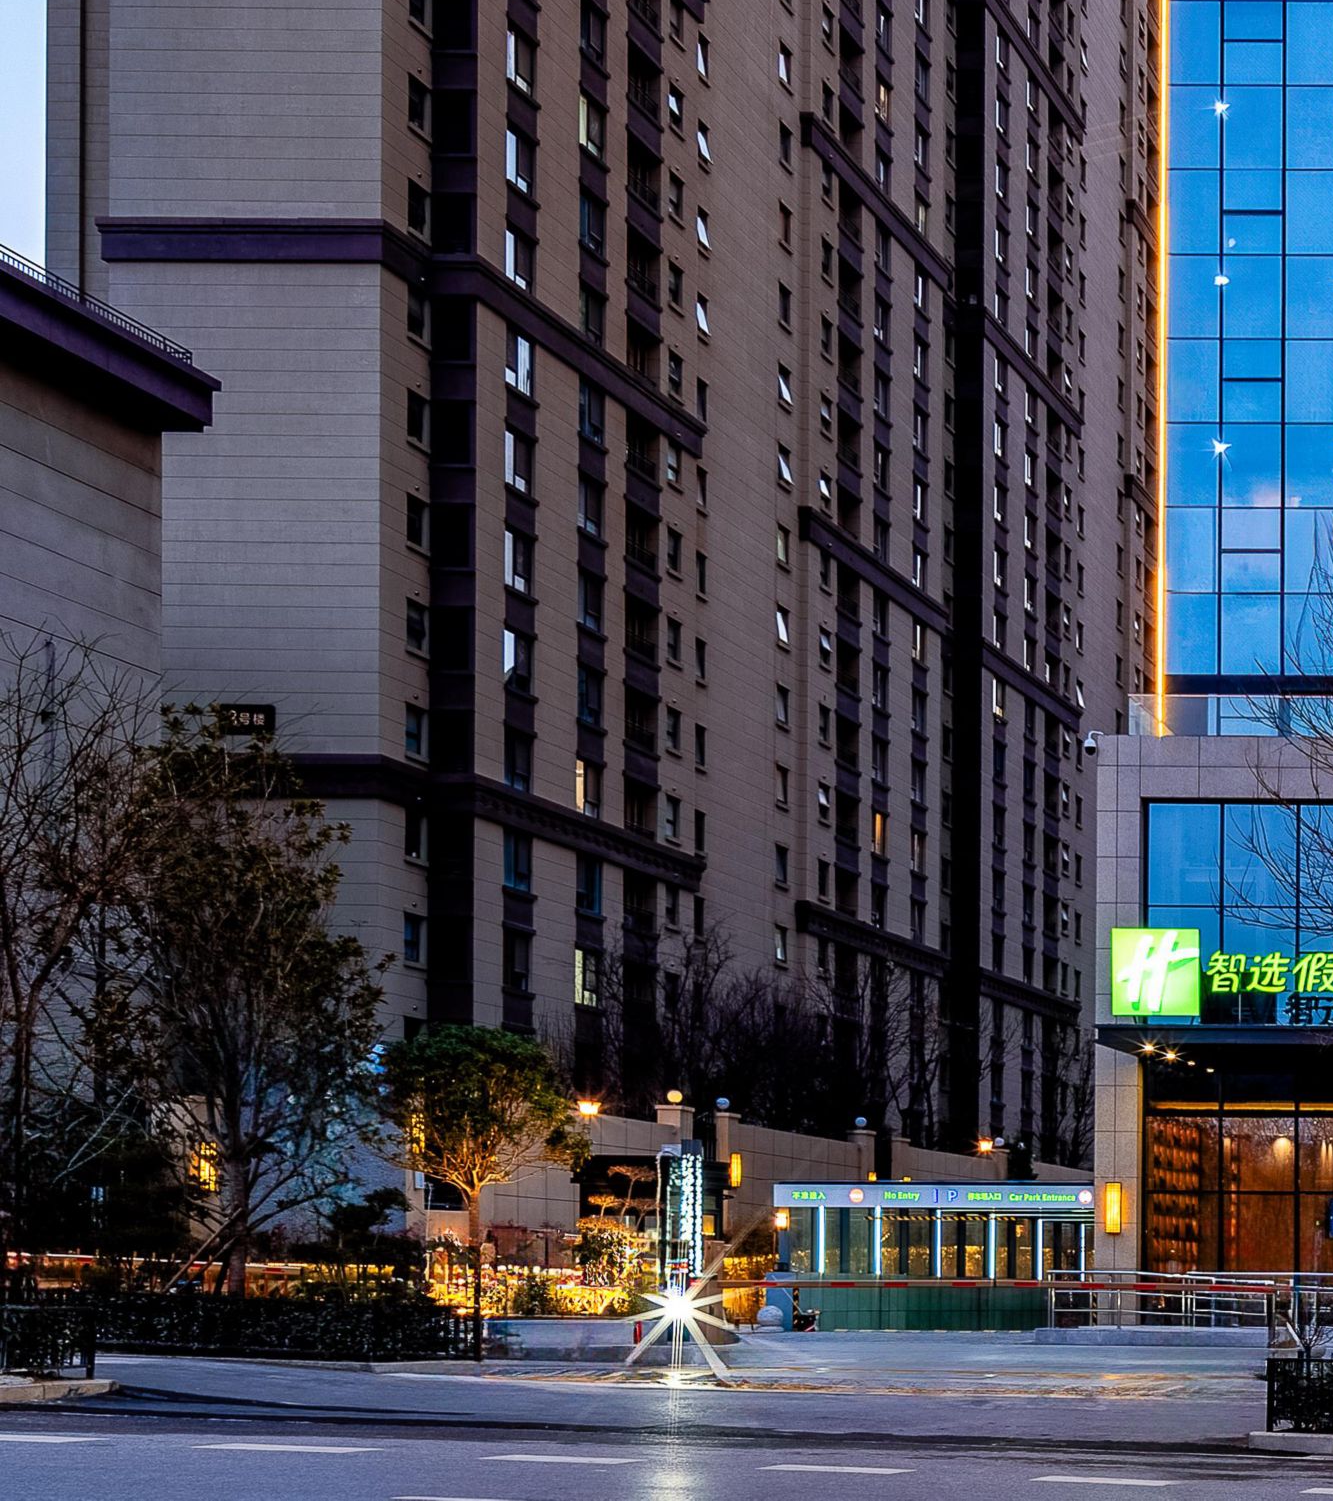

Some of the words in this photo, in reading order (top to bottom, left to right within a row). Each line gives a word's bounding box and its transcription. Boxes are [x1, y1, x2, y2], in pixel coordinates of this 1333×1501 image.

[884, 1191, 897, 1200] No
[898, 1191, 920, 1202] Entry
[1009, 1193, 1023, 1202] Car
[1023, 1193, 1041, 1202] Park
